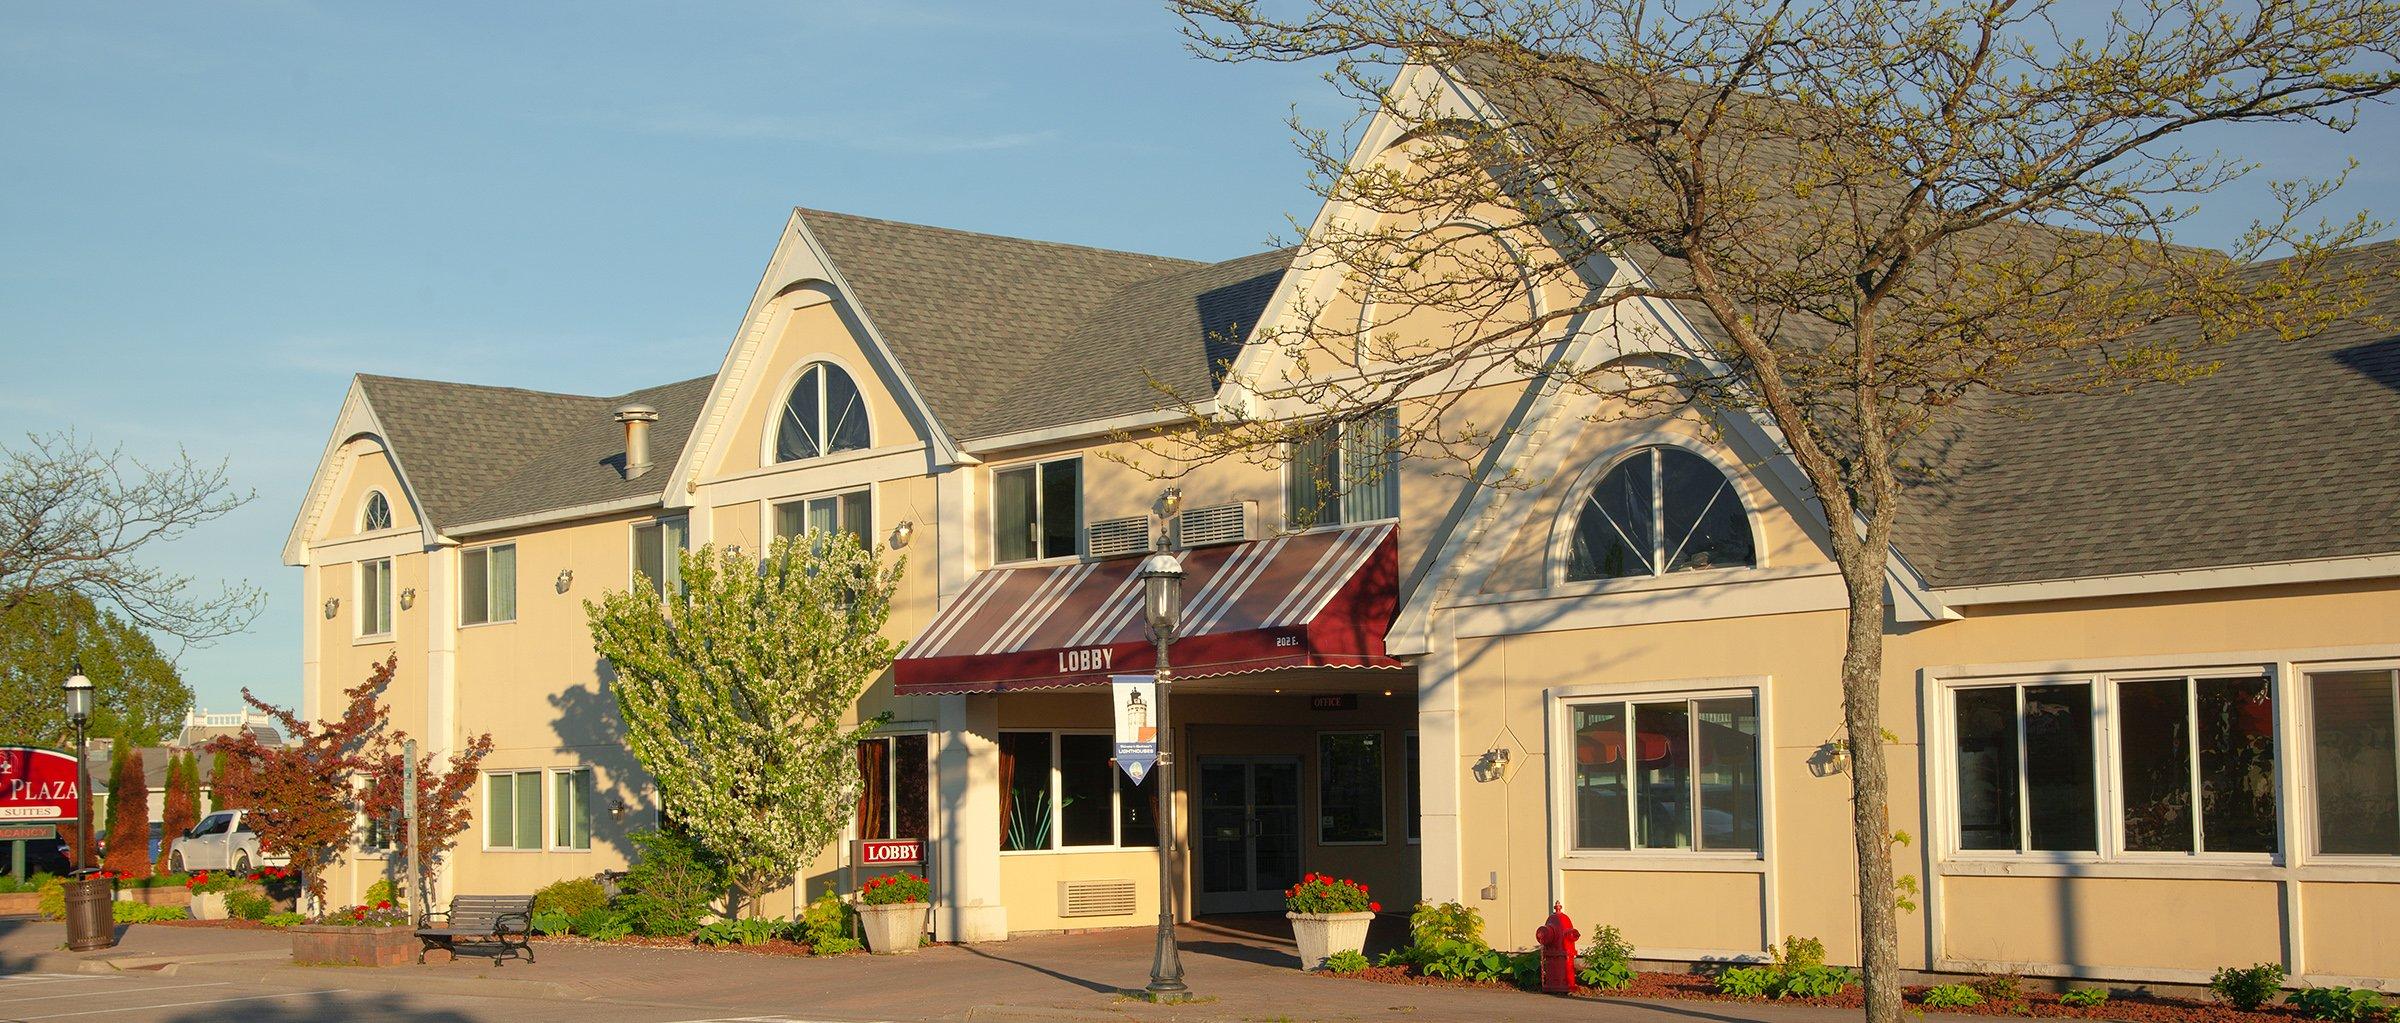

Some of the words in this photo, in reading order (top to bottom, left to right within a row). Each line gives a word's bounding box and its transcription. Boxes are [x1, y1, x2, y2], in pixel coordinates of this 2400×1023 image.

[1276, 637, 1291, 647] 202
[1059, 648, 1113, 673] LOBBY
[10, 778, 78, 800] PLAZA
[5, 808, 51, 816] SUITES
[868, 845, 919, 860] LOBBY
